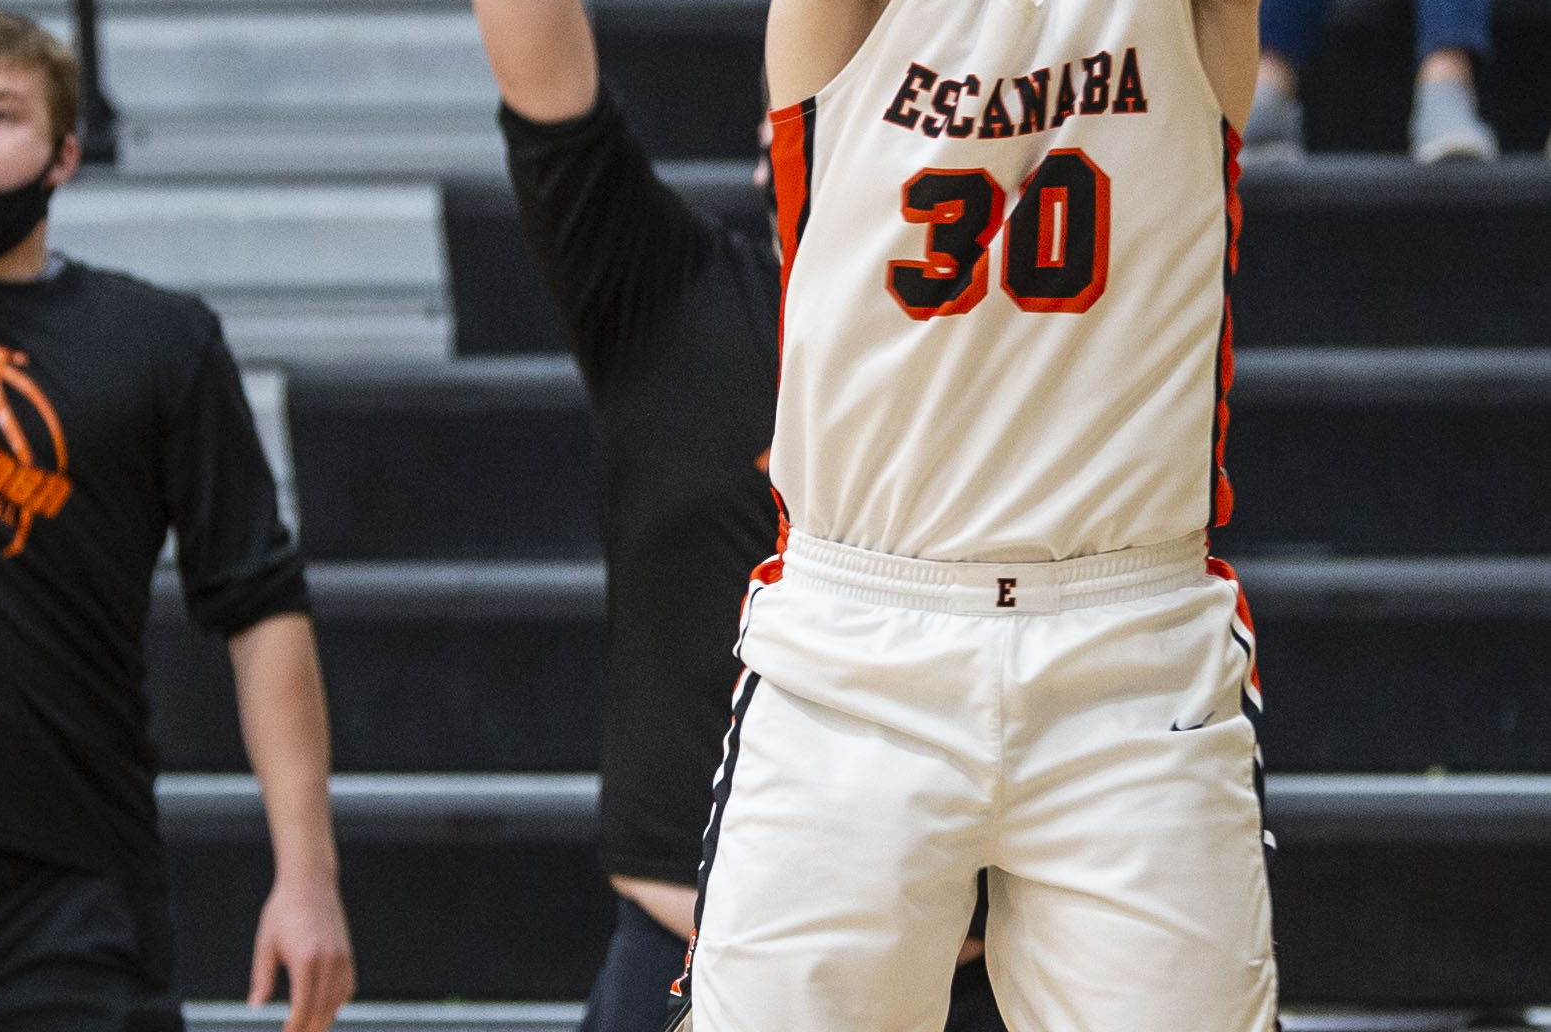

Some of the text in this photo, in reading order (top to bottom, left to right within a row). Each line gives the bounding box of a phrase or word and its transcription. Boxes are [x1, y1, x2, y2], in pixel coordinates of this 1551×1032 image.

[882, 47, 1148, 140] ESCANABA
[885, 147, 1111, 322] 30
[996, 577, 1018, 608] E
